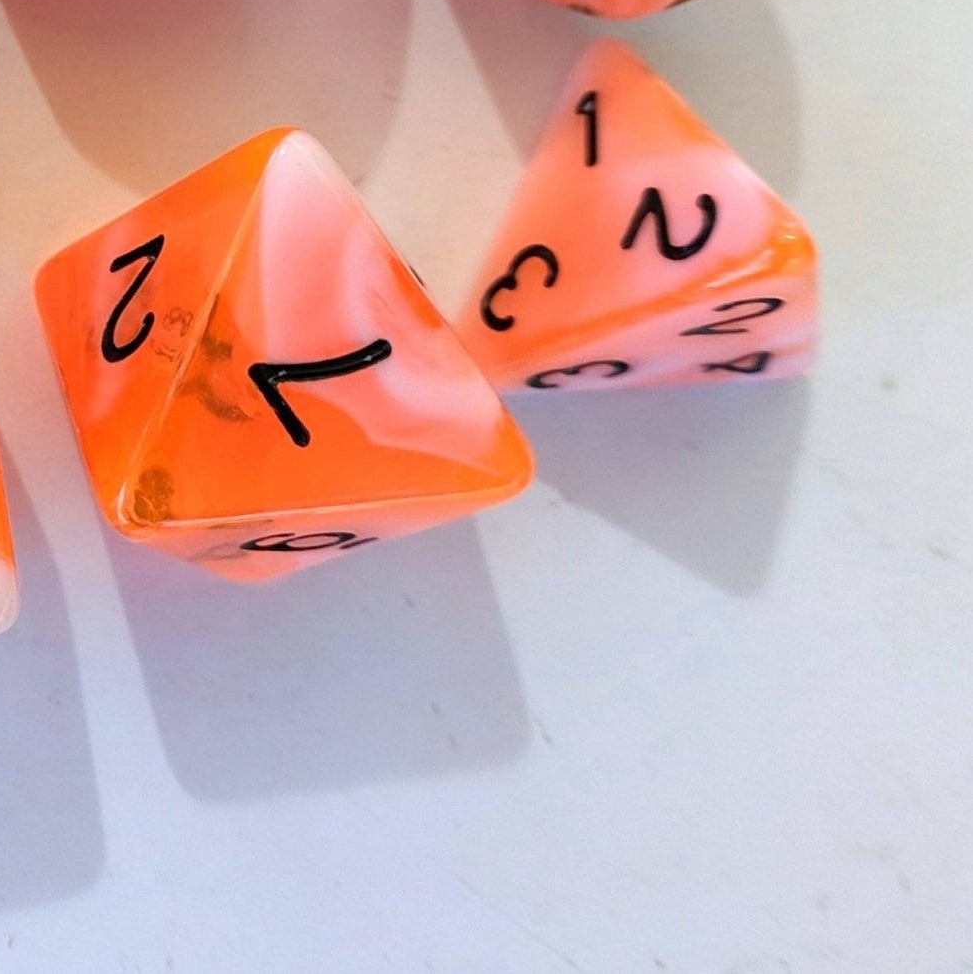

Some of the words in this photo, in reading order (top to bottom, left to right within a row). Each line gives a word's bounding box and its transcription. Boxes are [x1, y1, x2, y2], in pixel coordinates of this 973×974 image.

[575, 89, 600, 168] 1
[620, 186, 719, 262] 2
[100, 233, 166, 364] 2
[480, 243, 561, 334] 3
[678, 297, 785, 337] 2
[525, 359, 631, 390] 3
